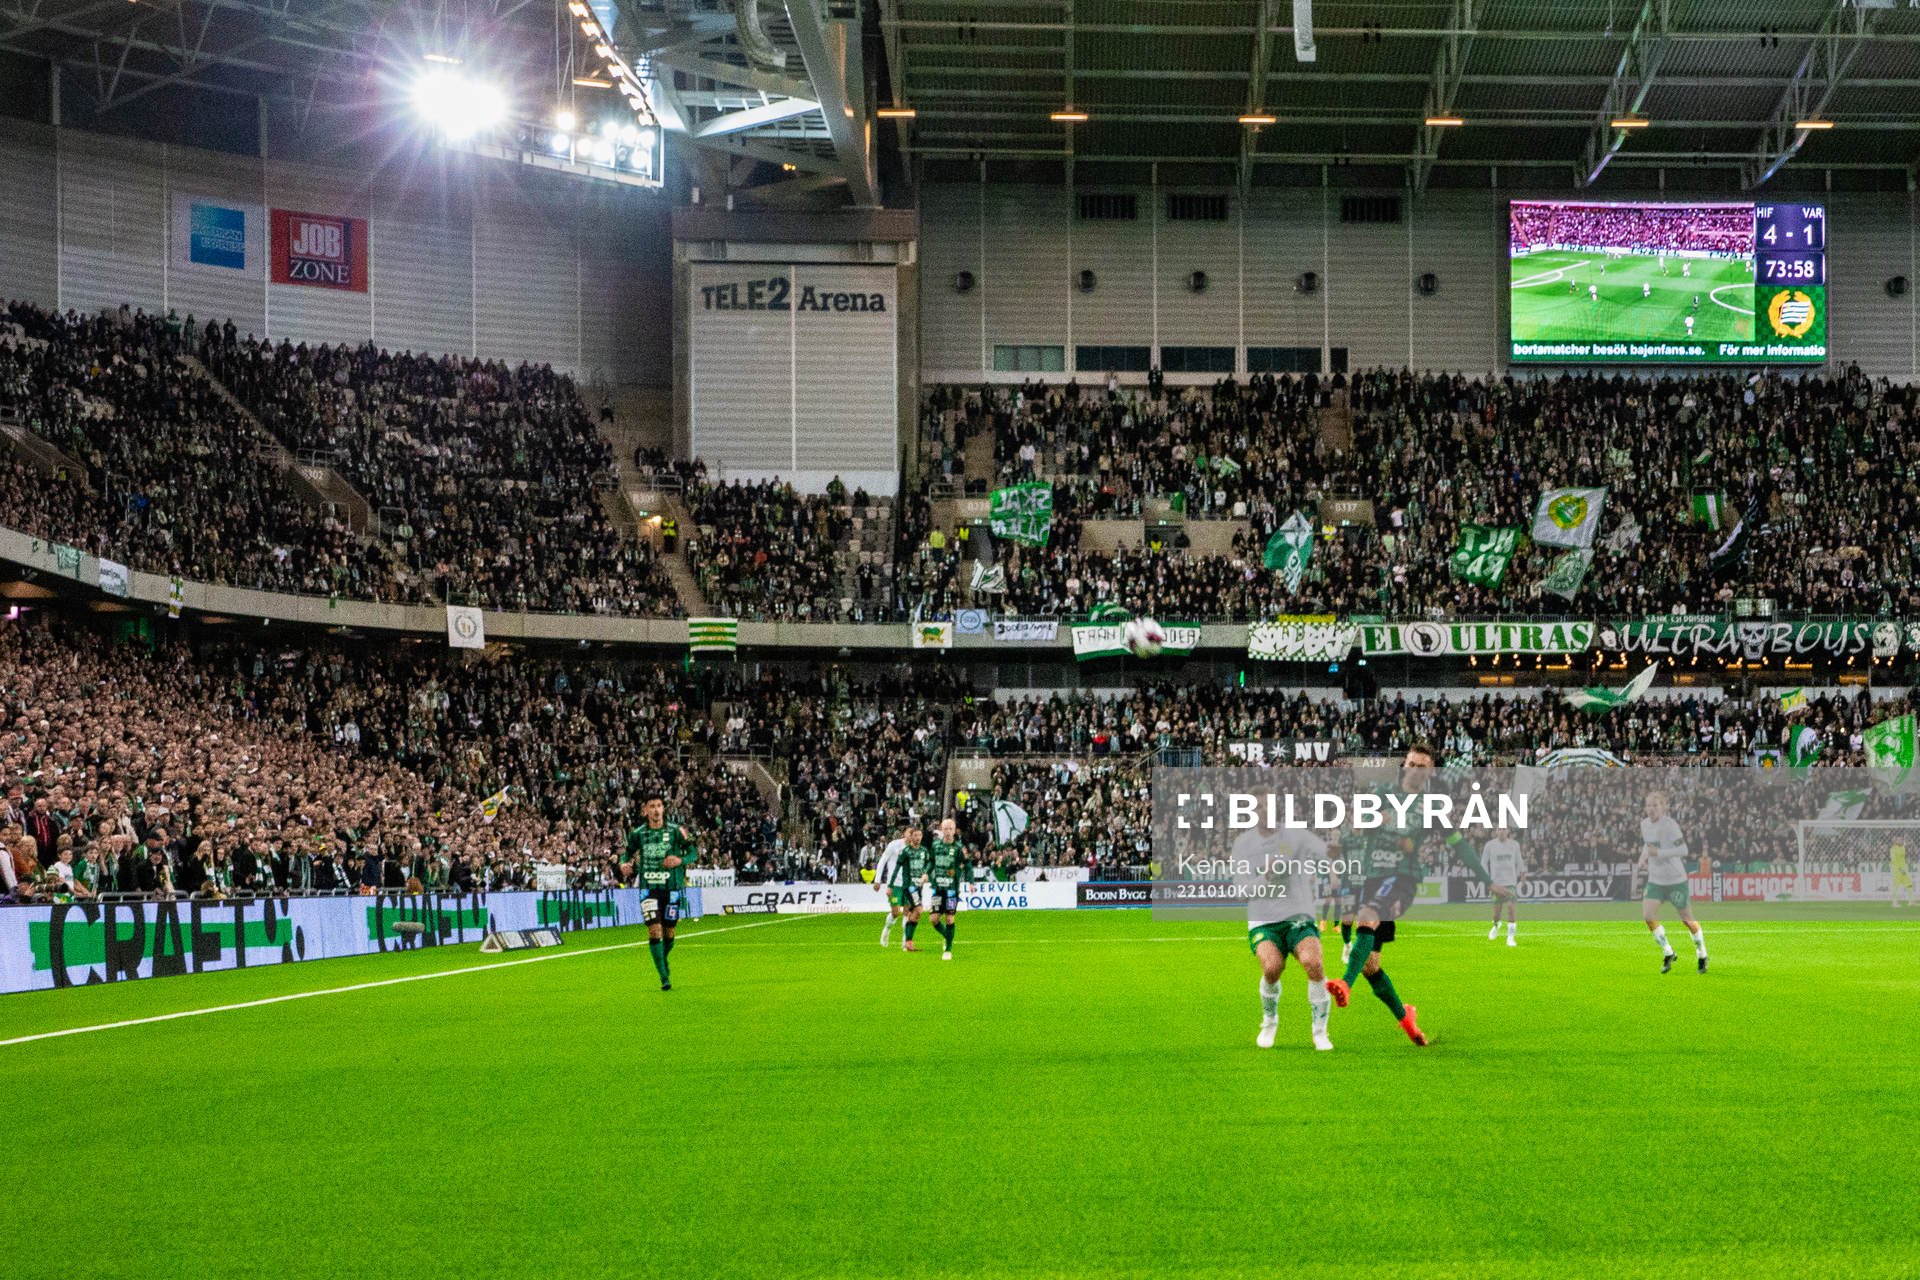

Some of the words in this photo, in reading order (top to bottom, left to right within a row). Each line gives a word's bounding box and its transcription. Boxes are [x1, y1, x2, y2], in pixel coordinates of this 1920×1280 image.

[1756, 208, 1774, 218] HIF
[1803, 208, 1823, 218] VAR
[293, 222, 342, 258] JOB
[1763, 225, 1777, 243] 4
[1803, 225, 1813, 244] 1
[290, 260, 350, 284] ZONE
[1765, 260, 1815, 278] 73:58
[701, 277, 791, 311] TELE2
[799, 286, 887, 312] Arena
[1513, 343, 1590, 356] bortamatcher
[1592, 343, 1628, 356] besök
[1719, 343, 1739, 356] För
[1742, 346, 1764, 356] mer
[1451, 624, 1590, 653] ULTRAS
[1619, 622, 1740, 656] ULTRA
[1768, 622, 1868, 656] BOYS
[1295, 741, 1330, 762] NV
[643, 871, 671, 881] coop
[746, 891, 822, 906] CRAFT
[1007, 896, 1028, 908] AB
[1085, 888, 1118, 900] BODIN
[1119, 888, 1147, 900] BYGG
[49, 900, 254, 988] CRAFT
